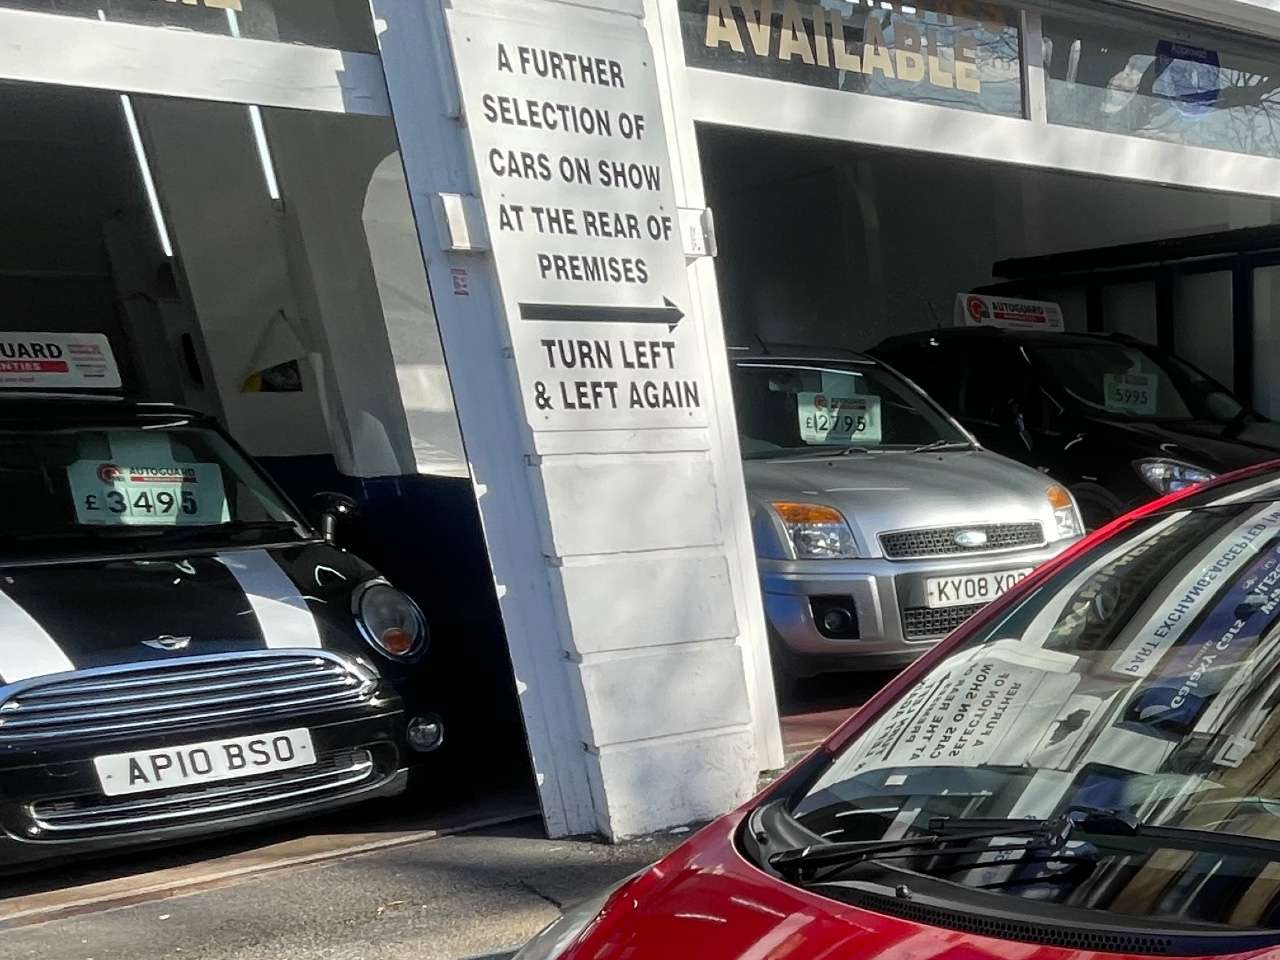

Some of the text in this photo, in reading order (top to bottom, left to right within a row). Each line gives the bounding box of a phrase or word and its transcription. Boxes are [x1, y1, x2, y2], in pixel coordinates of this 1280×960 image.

[706, 0, 981, 94] AVAILABLE
[497, 43, 625, 88] A FURTHER
[482, 93, 646, 140] SELECTION OF
[489, 148, 661, 191] CARS ON SHOW
[500, 204, 673, 241] AT THE REAR OF
[537, 254, 649, 284] PREMISES
[541, 339, 676, 369] TURN LEFT
[534, 381, 700, 410] & LEFT AGAIN
[129, 466, 195, 477] AUTOGUARD
[84, 489, 199, 516] £3495
[937, 576, 989, 603] KY08
[128, 735, 296, 786] AP10 BSO
